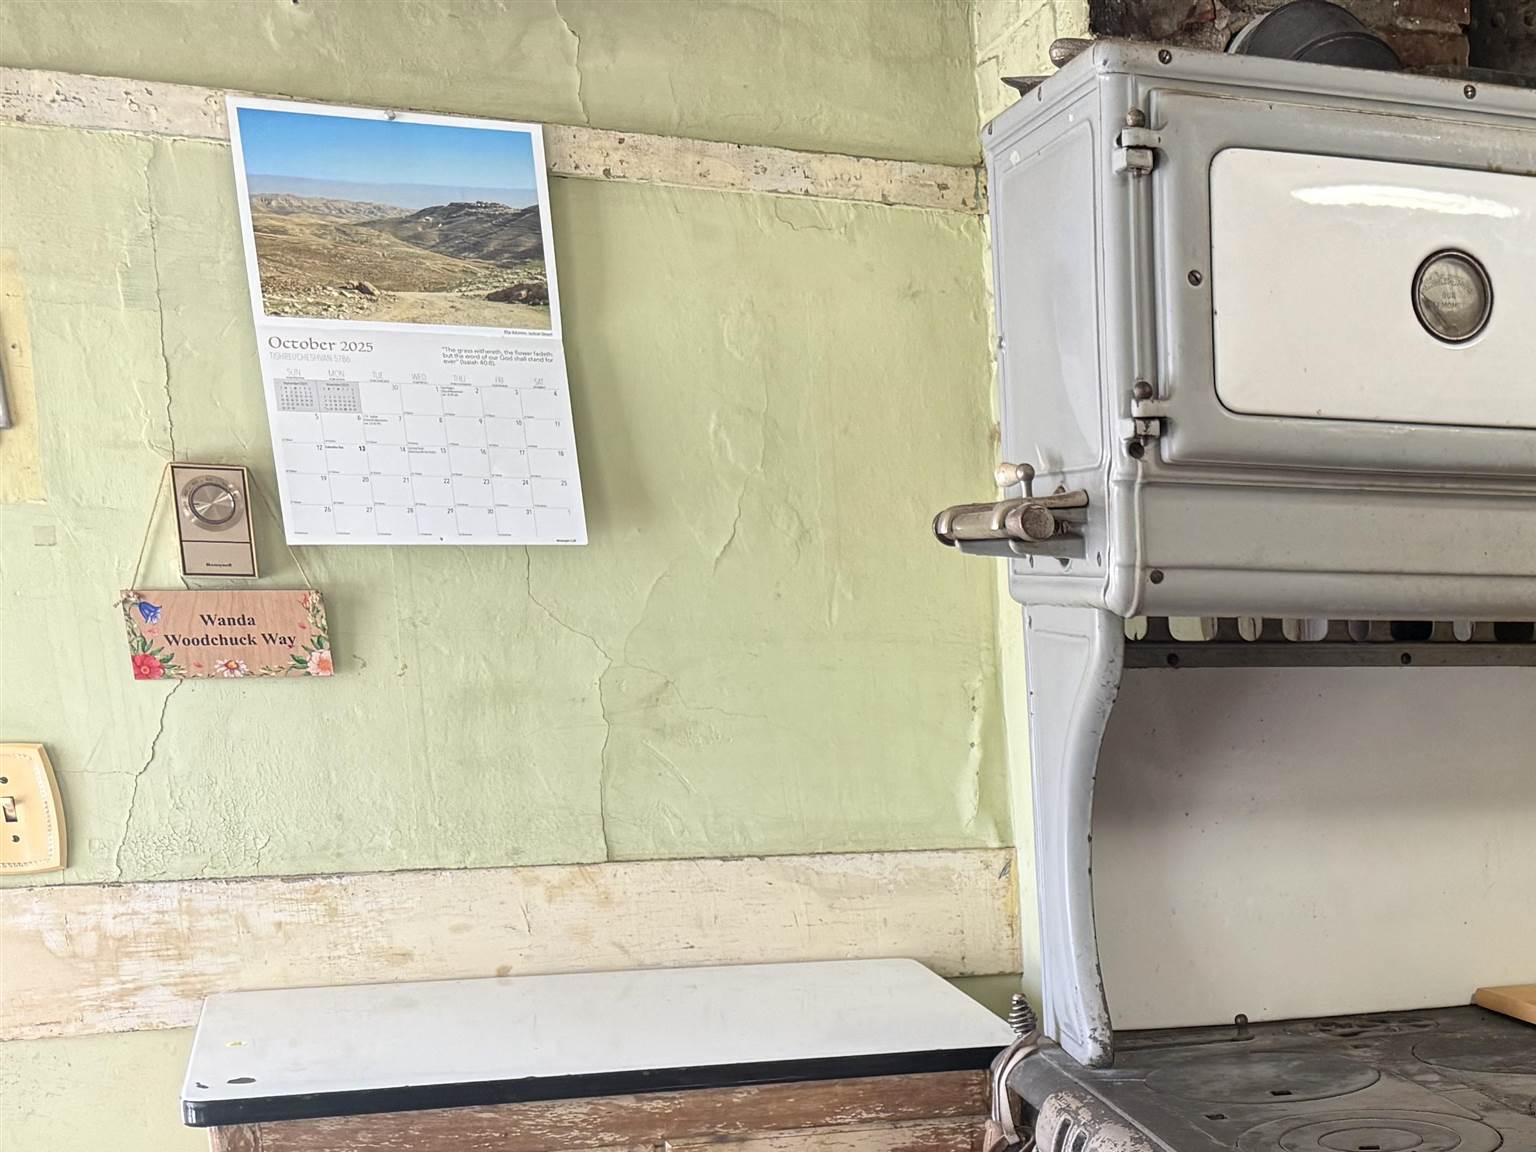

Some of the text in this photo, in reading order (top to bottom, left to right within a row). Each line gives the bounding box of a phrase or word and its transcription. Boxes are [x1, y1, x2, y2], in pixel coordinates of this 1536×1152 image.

[268, 335, 375, 353] October 2025
[199, 614, 257, 626] Wanda
[164, 633, 297, 649] Woodchuck Way
